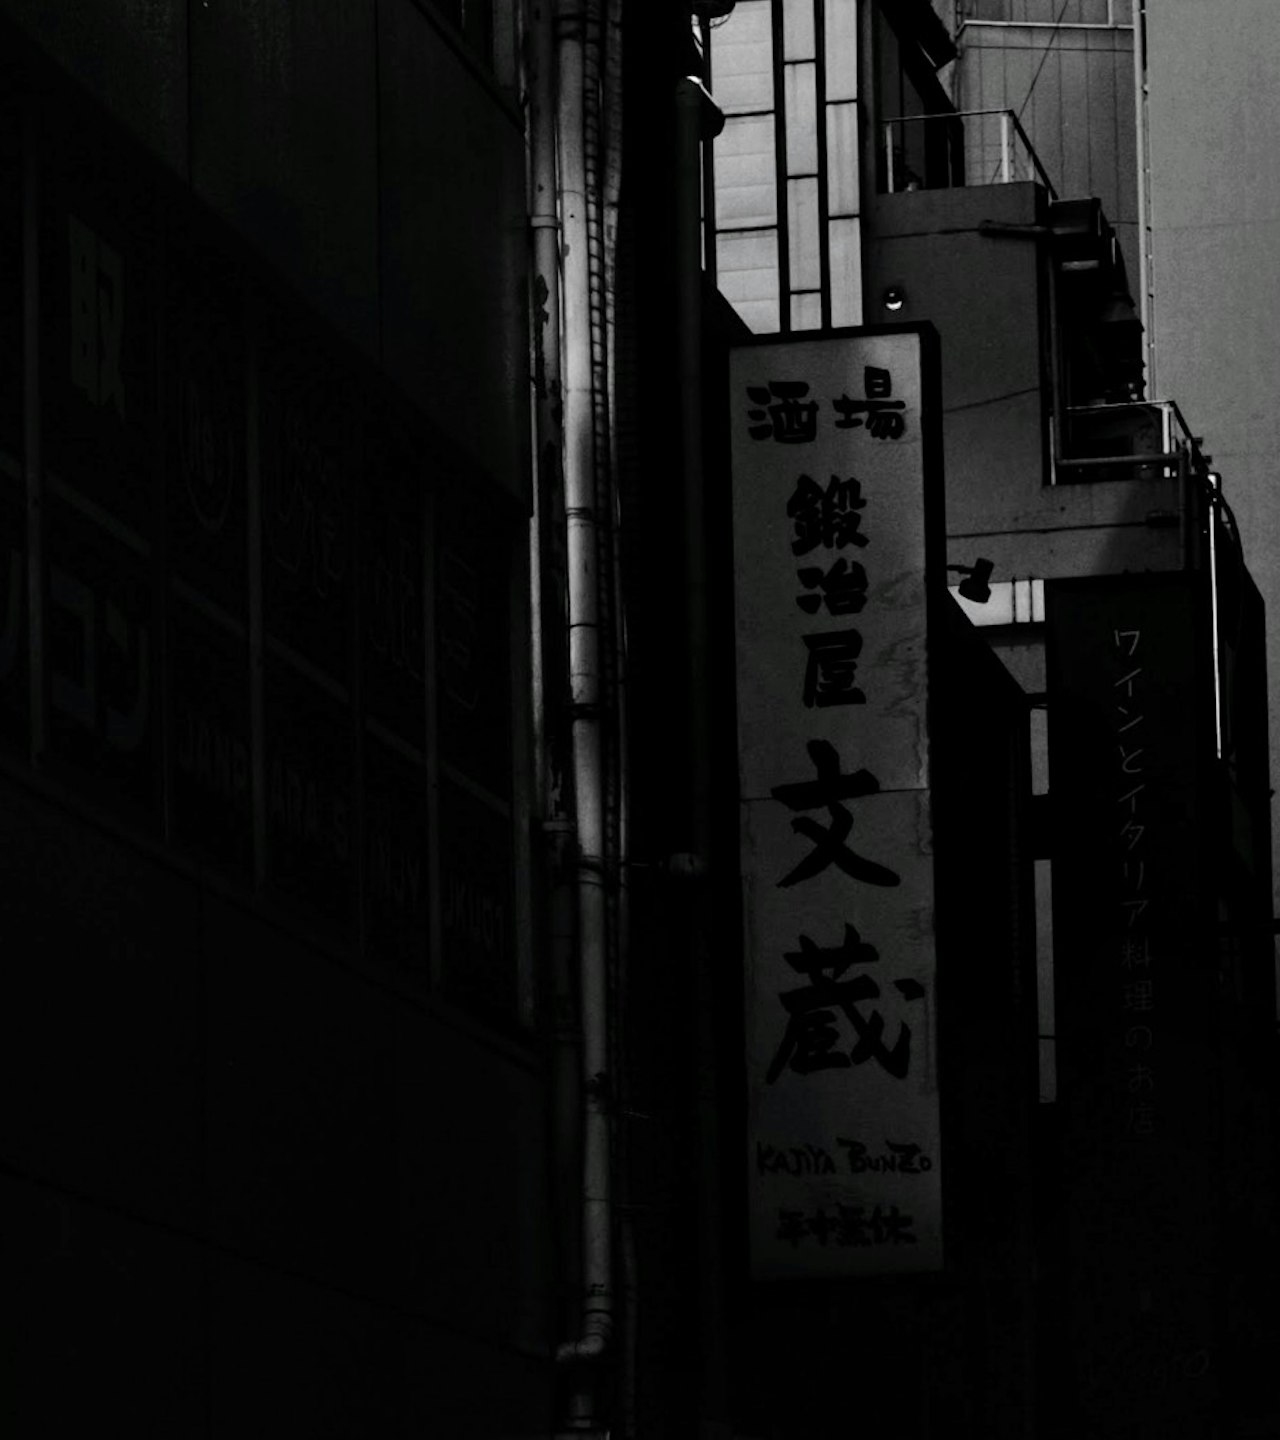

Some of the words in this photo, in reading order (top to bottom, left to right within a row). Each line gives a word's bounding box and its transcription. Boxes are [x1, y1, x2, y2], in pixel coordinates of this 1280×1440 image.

[746, 366, 906, 445] 酒場
[786, 473, 870, 709] 鍛冶屋
[764, 738, 926, 1086] 文蔵
[756, 1141, 836, 1176] KAJIYA
